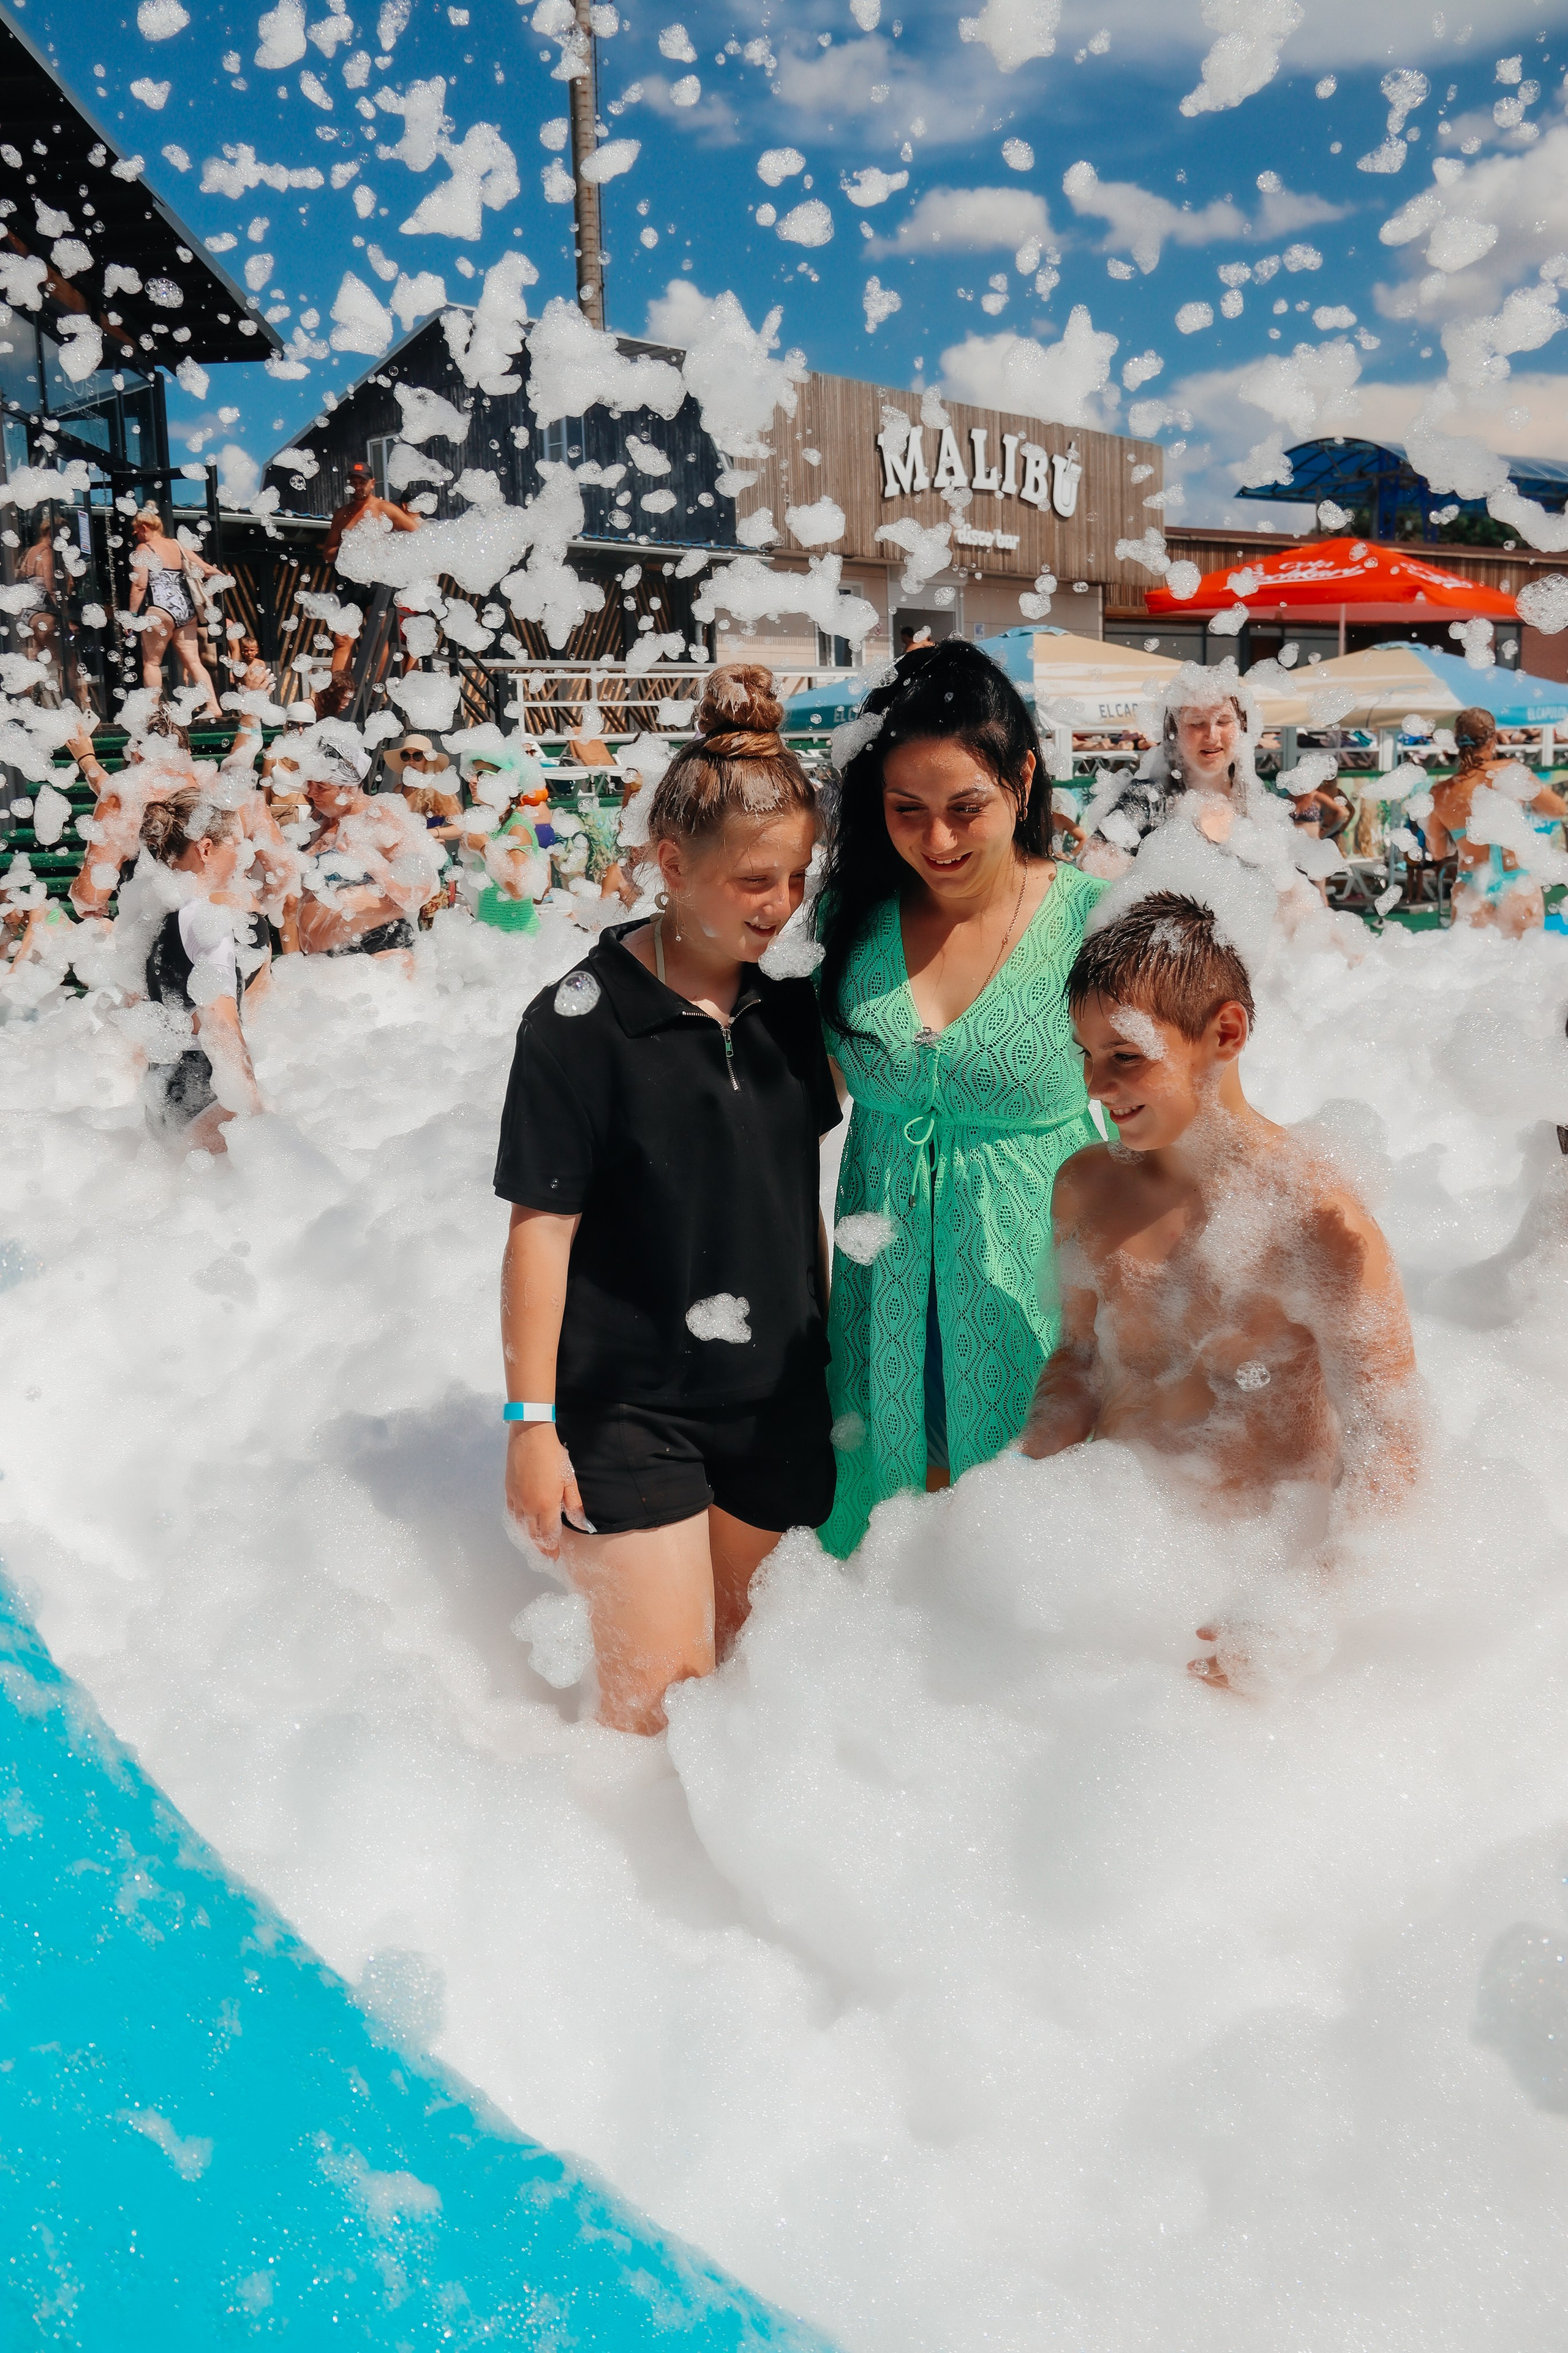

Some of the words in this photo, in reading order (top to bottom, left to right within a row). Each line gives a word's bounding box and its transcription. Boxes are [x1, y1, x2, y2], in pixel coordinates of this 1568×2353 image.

[878, 424, 1082, 518] MALIBU
[954, 524, 993, 547] disco
[994, 529, 1020, 550] bar
